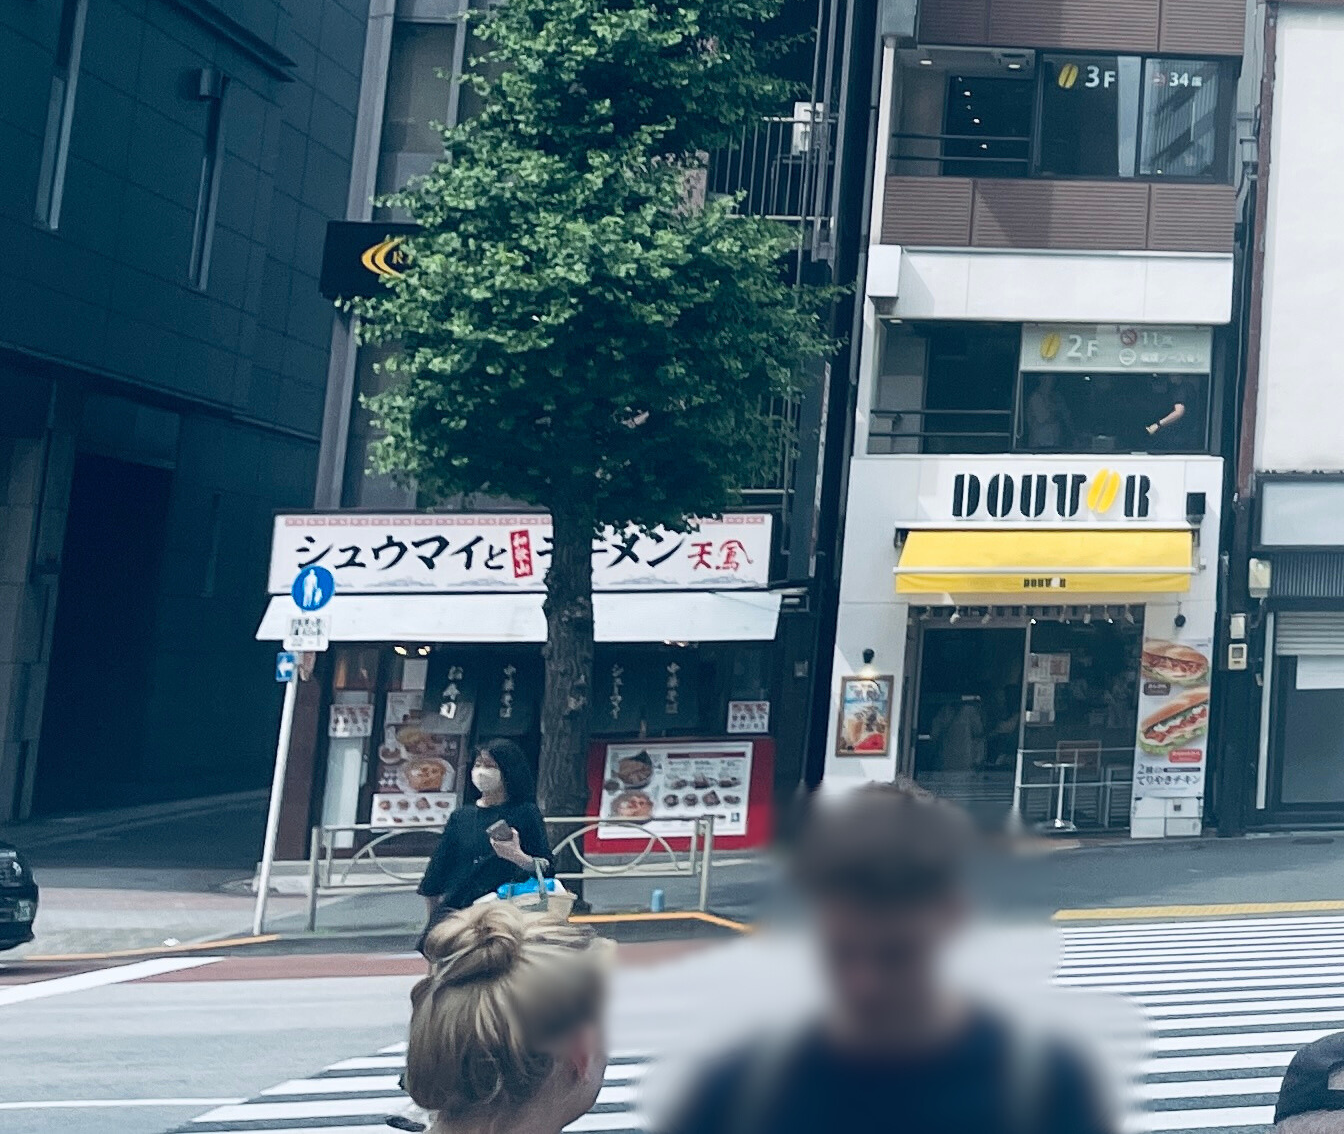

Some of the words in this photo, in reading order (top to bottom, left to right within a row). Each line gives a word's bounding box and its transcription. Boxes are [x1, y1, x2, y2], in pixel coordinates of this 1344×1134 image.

[1085, 65, 1116, 88] 3F
[1066, 334, 1099, 358] 2F
[296, 535, 506, 570] シュウマイと
